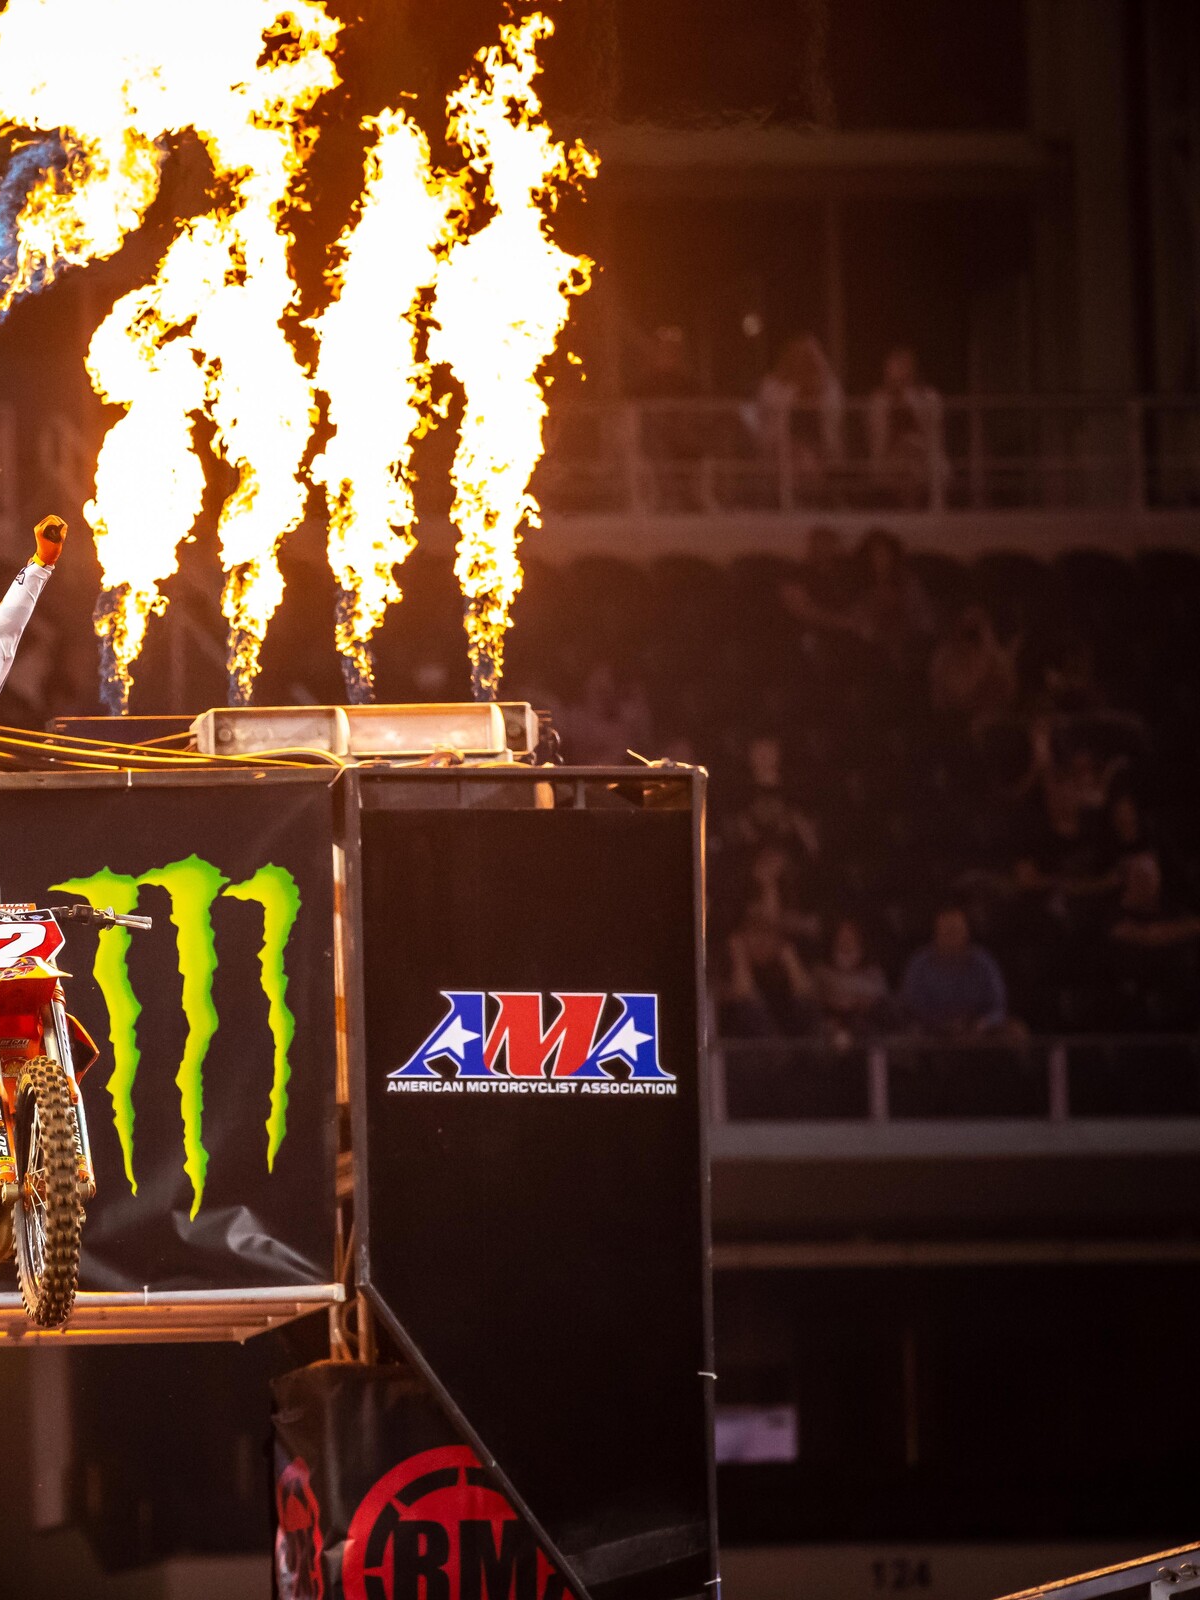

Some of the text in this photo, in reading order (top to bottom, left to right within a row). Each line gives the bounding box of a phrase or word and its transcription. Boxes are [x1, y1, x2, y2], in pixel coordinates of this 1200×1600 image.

[386, 991, 677, 1081] AMA
[386, 1080, 677, 1095] AMERICAN MOTORCYCLIST ASSOCIATION
